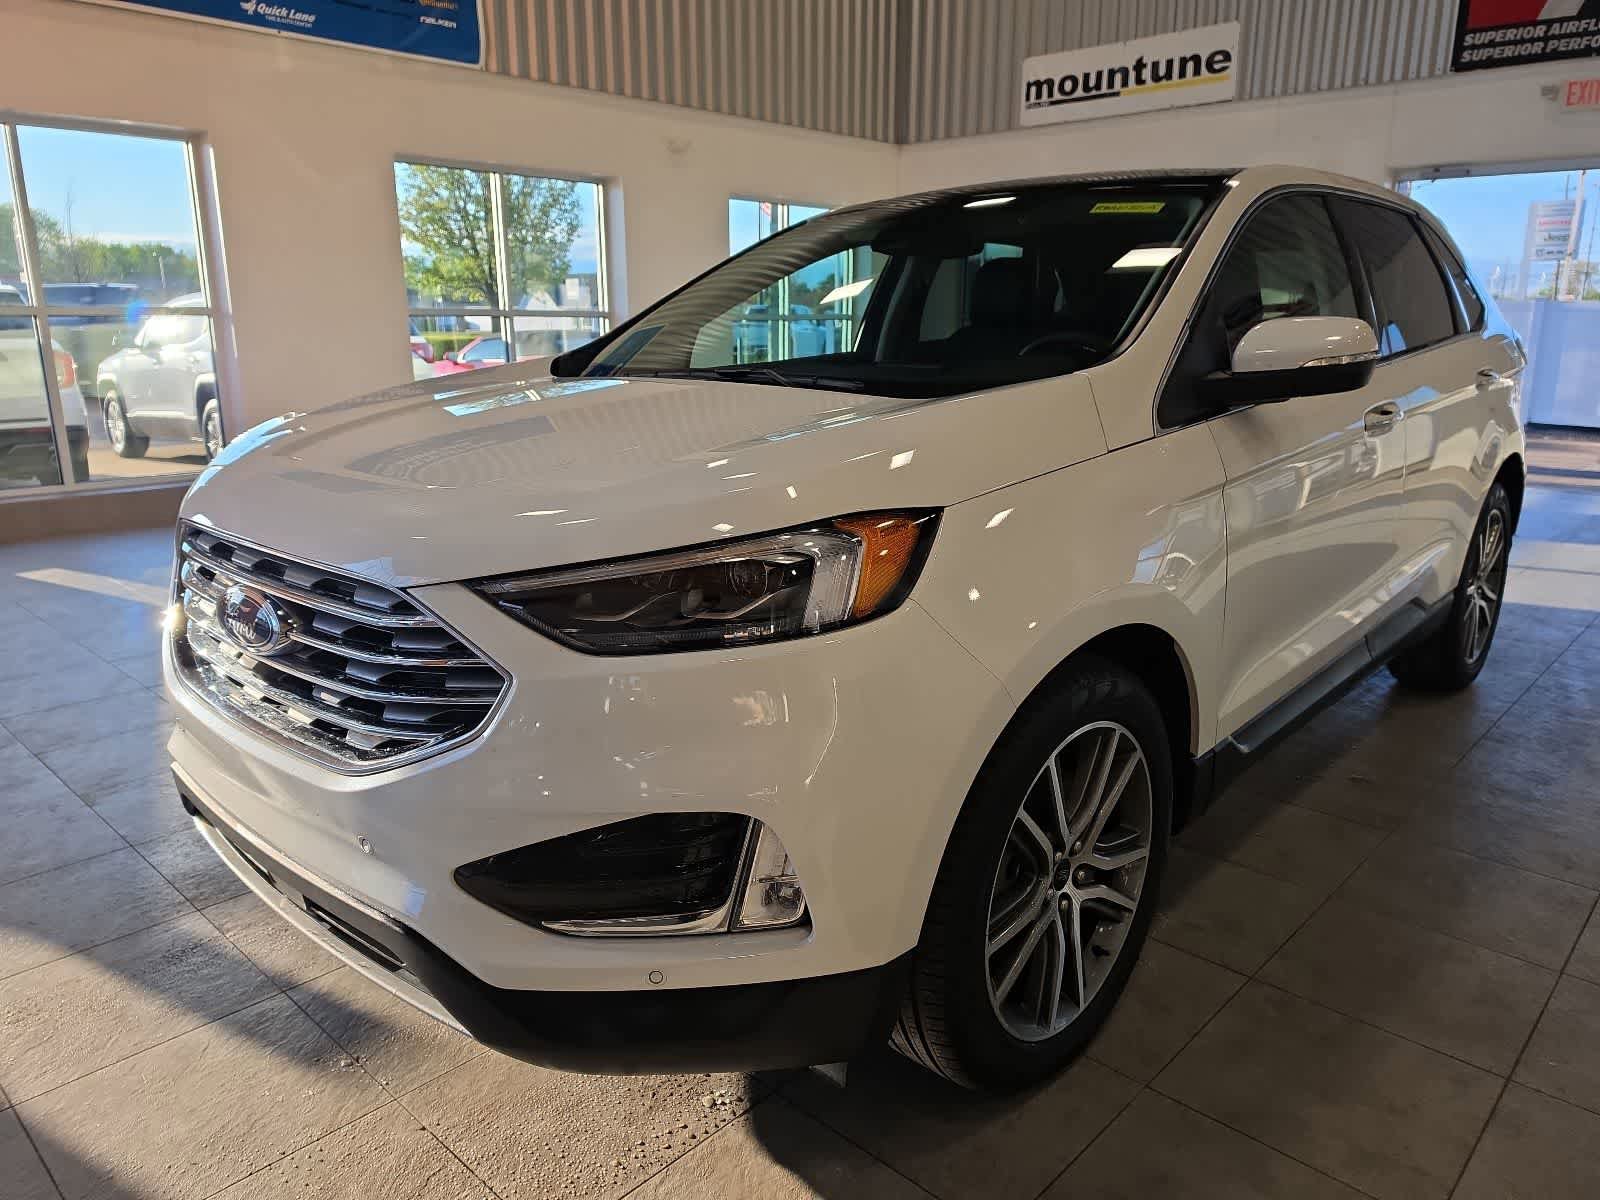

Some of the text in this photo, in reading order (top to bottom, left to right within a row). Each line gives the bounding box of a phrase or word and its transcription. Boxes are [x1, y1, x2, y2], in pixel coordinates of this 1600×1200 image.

[257, 3, 288, 17] Quick
[289, 9, 316, 23] Lane
[1464, 18, 1600, 46] SUPERIOR AIRFL
[1461, 41, 1545, 62] SUPERIOR
[1025, 49, 1232, 102] mountune
